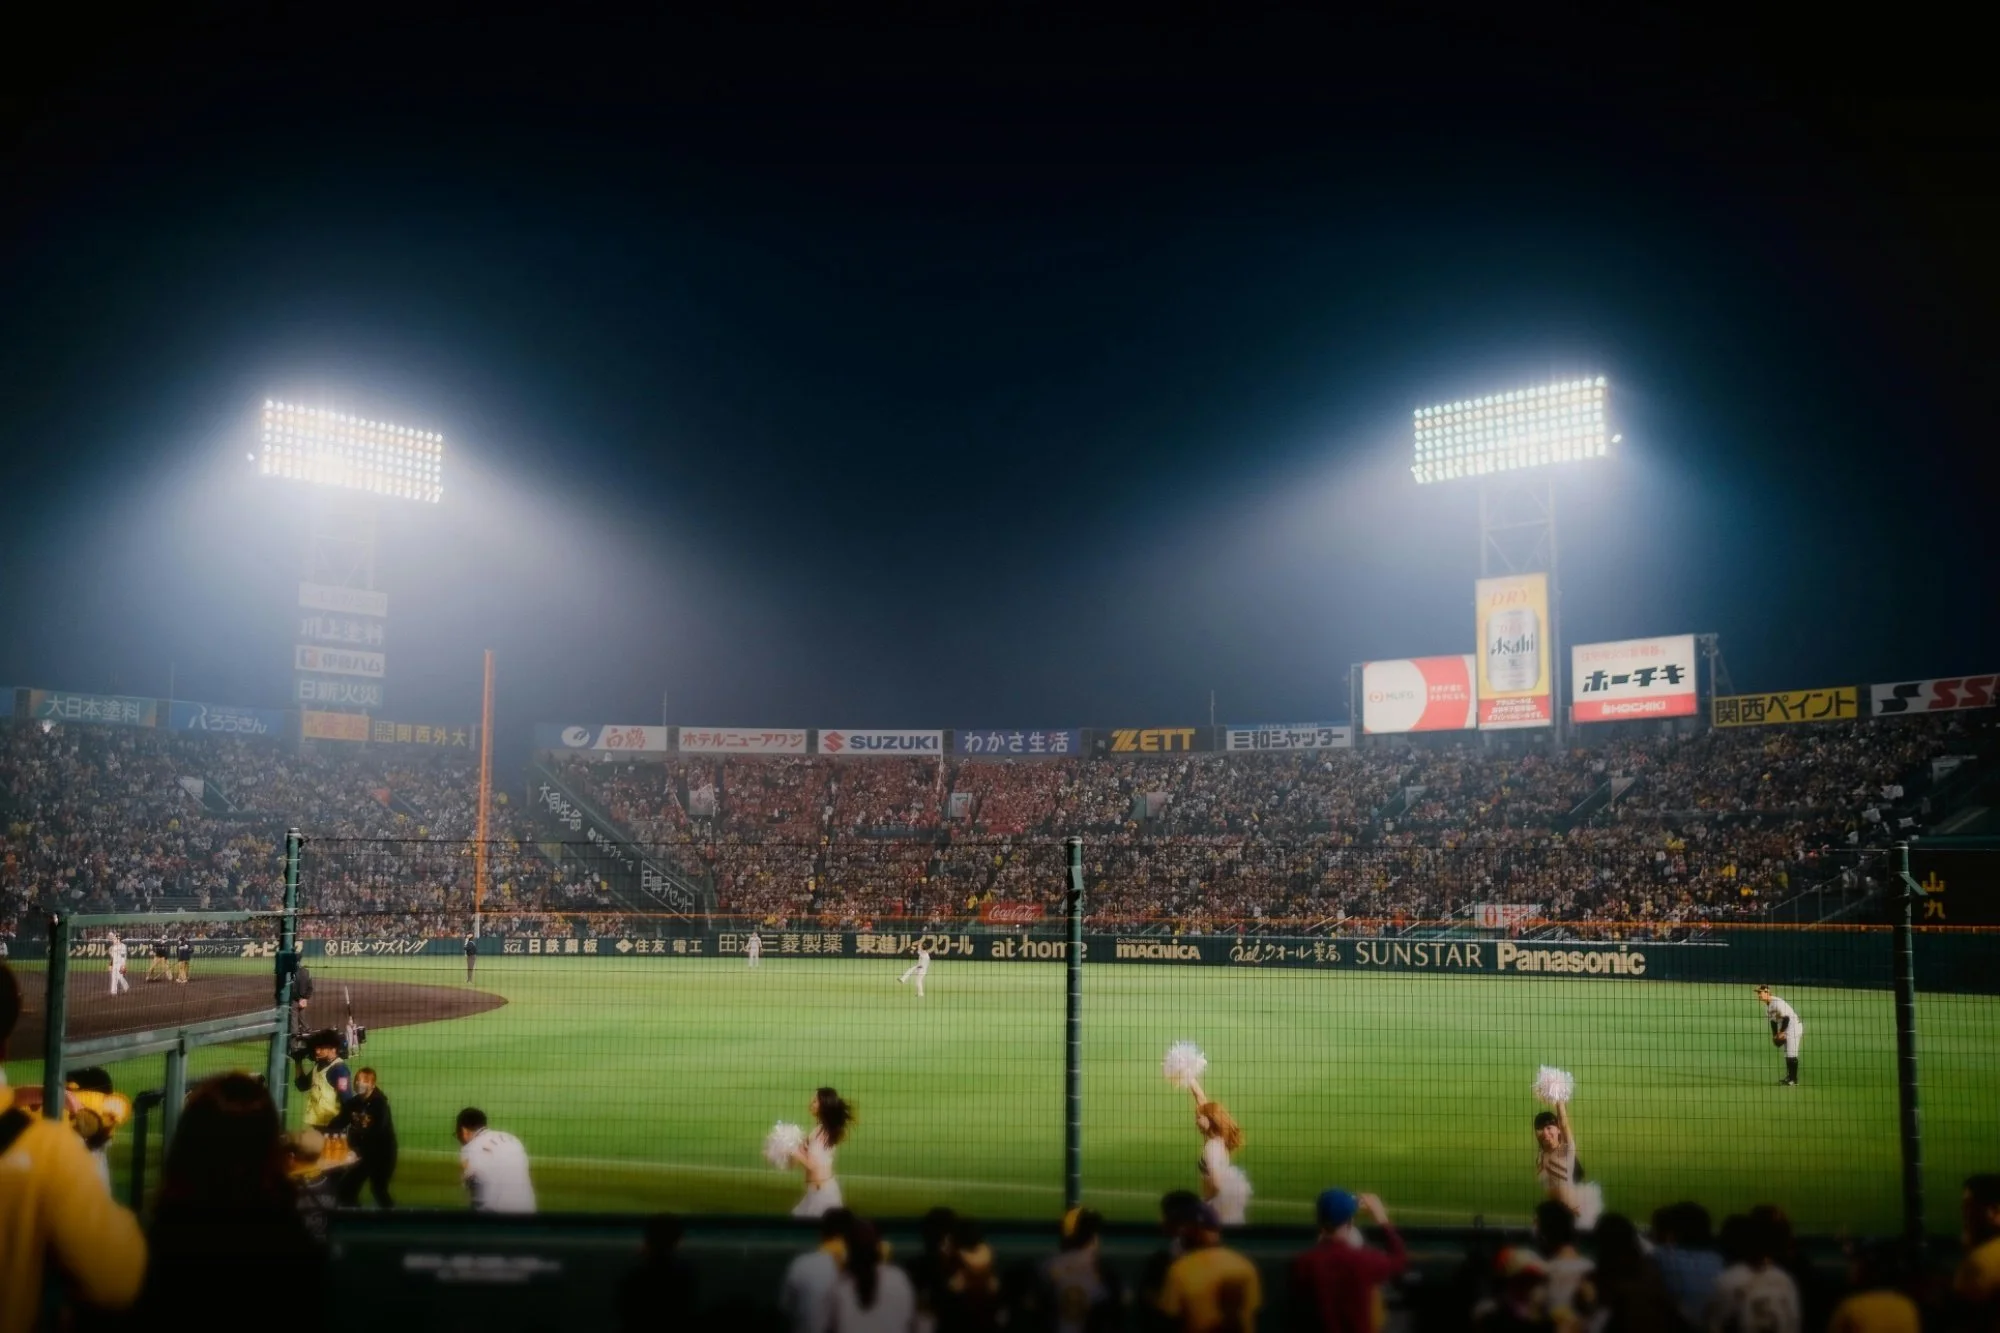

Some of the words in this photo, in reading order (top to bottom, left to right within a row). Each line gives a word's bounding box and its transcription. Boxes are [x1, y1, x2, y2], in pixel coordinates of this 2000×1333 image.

[1490, 633, 1534, 656] Asahi
[1583, 664, 1686, 693] ホーチキ
[299, 680, 379, 705] 日新火災
[1385, 690, 1415, 700] MUFG
[1928, 674, 2000, 709] SS
[45, 694, 140, 725] 大日本塗料
[1715, 690, 1855, 725] 関西ペイント
[210, 714, 268, 735] ろうきん
[397, 723, 467, 747] 関西外大
[606, 728, 647, 749] 白鶴
[682, 731, 804, 748] ホテルニューアワジ
[850, 735, 939, 750] SUZUKI
[964, 731, 1069, 754] わかさ生活
[1111, 728, 1195, 753] ZETT
[1234, 728, 1345, 749] 三和シャッター
[539, 782, 583, 832] 大同生命
[340, 938, 428, 956] 日本ハウズイング
[528, 938, 599, 954] 日鉄鋼板
[635, 938, 703, 954] 住友電工
[991, 937, 1016, 958] at
[1355, 940, 1483, 967] SUNSTAR
[1497, 944, 1646, 975] Panasonic
